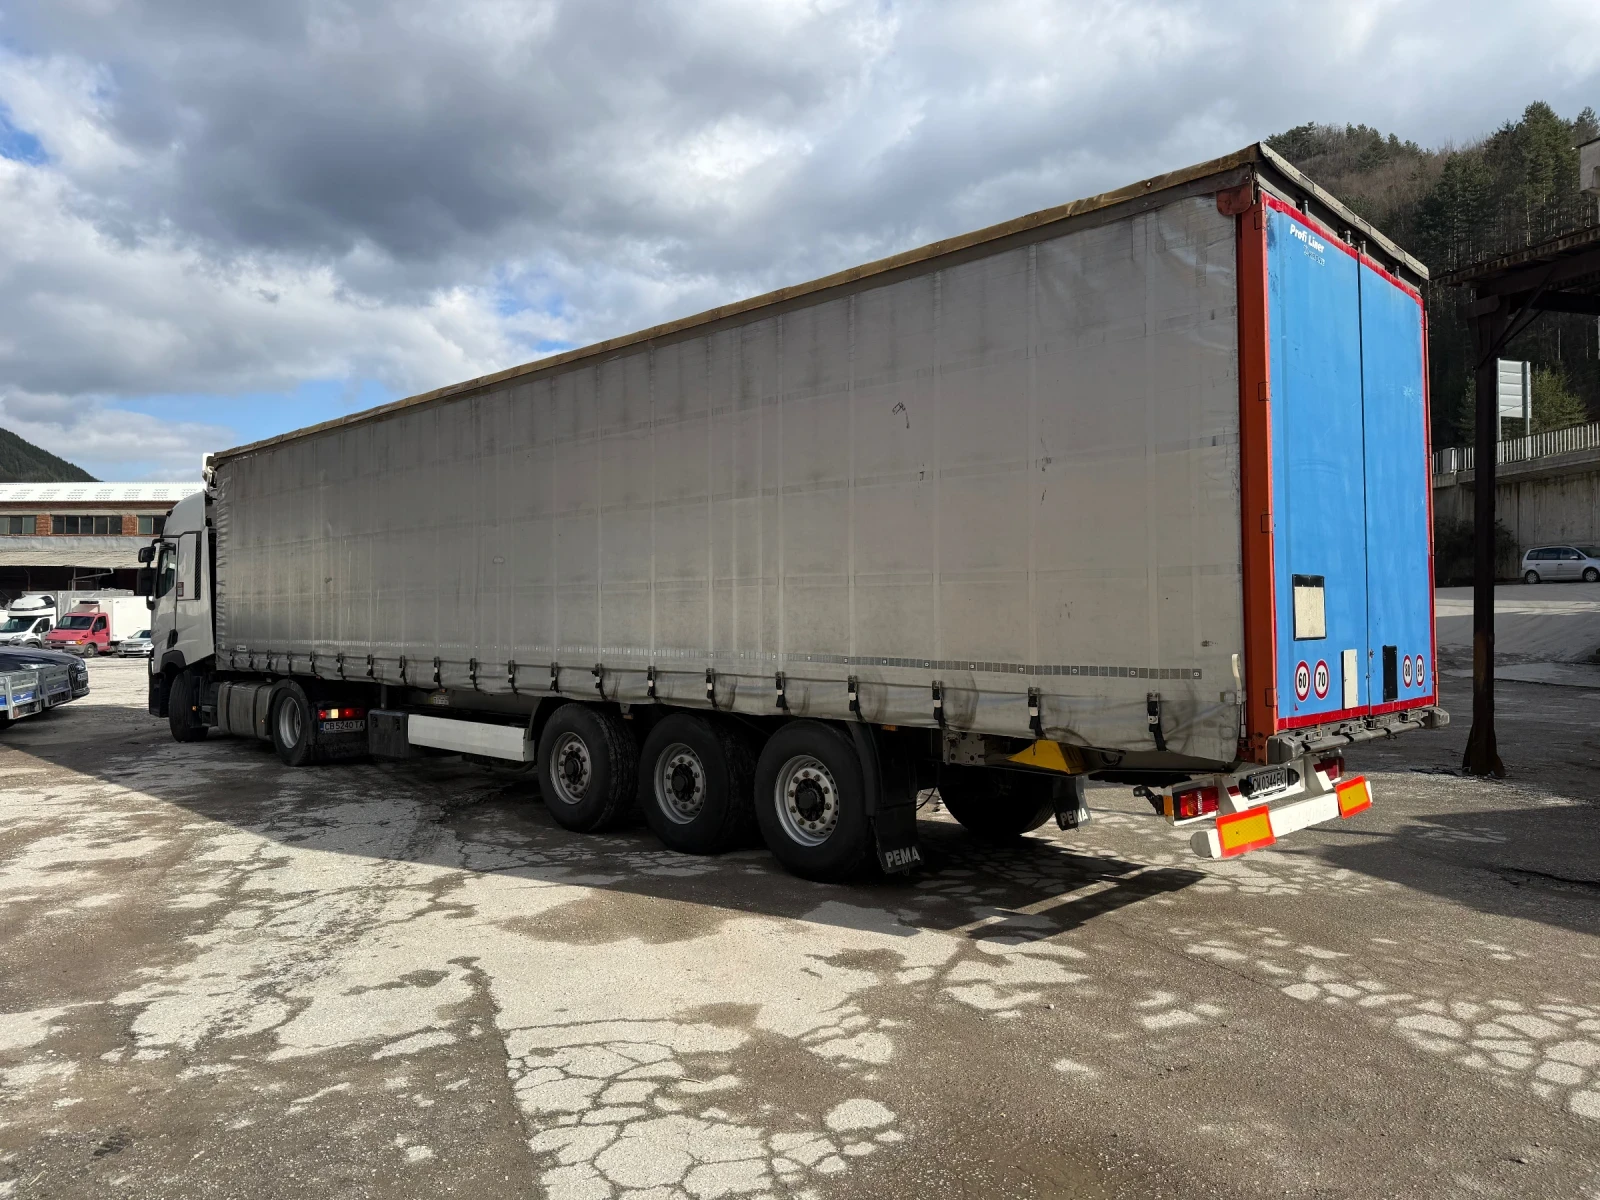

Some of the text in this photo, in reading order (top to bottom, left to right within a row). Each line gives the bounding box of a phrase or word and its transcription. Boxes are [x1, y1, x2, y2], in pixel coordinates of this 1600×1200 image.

[1290, 223, 1325, 253] Profi Liner
[1404, 663, 1411, 677] 80
[1298, 672, 1307, 689] 60
[1317, 671, 1326, 688] 70
[1060, 807, 1088, 826] PEMA
[885, 846, 921, 868] PEMA
